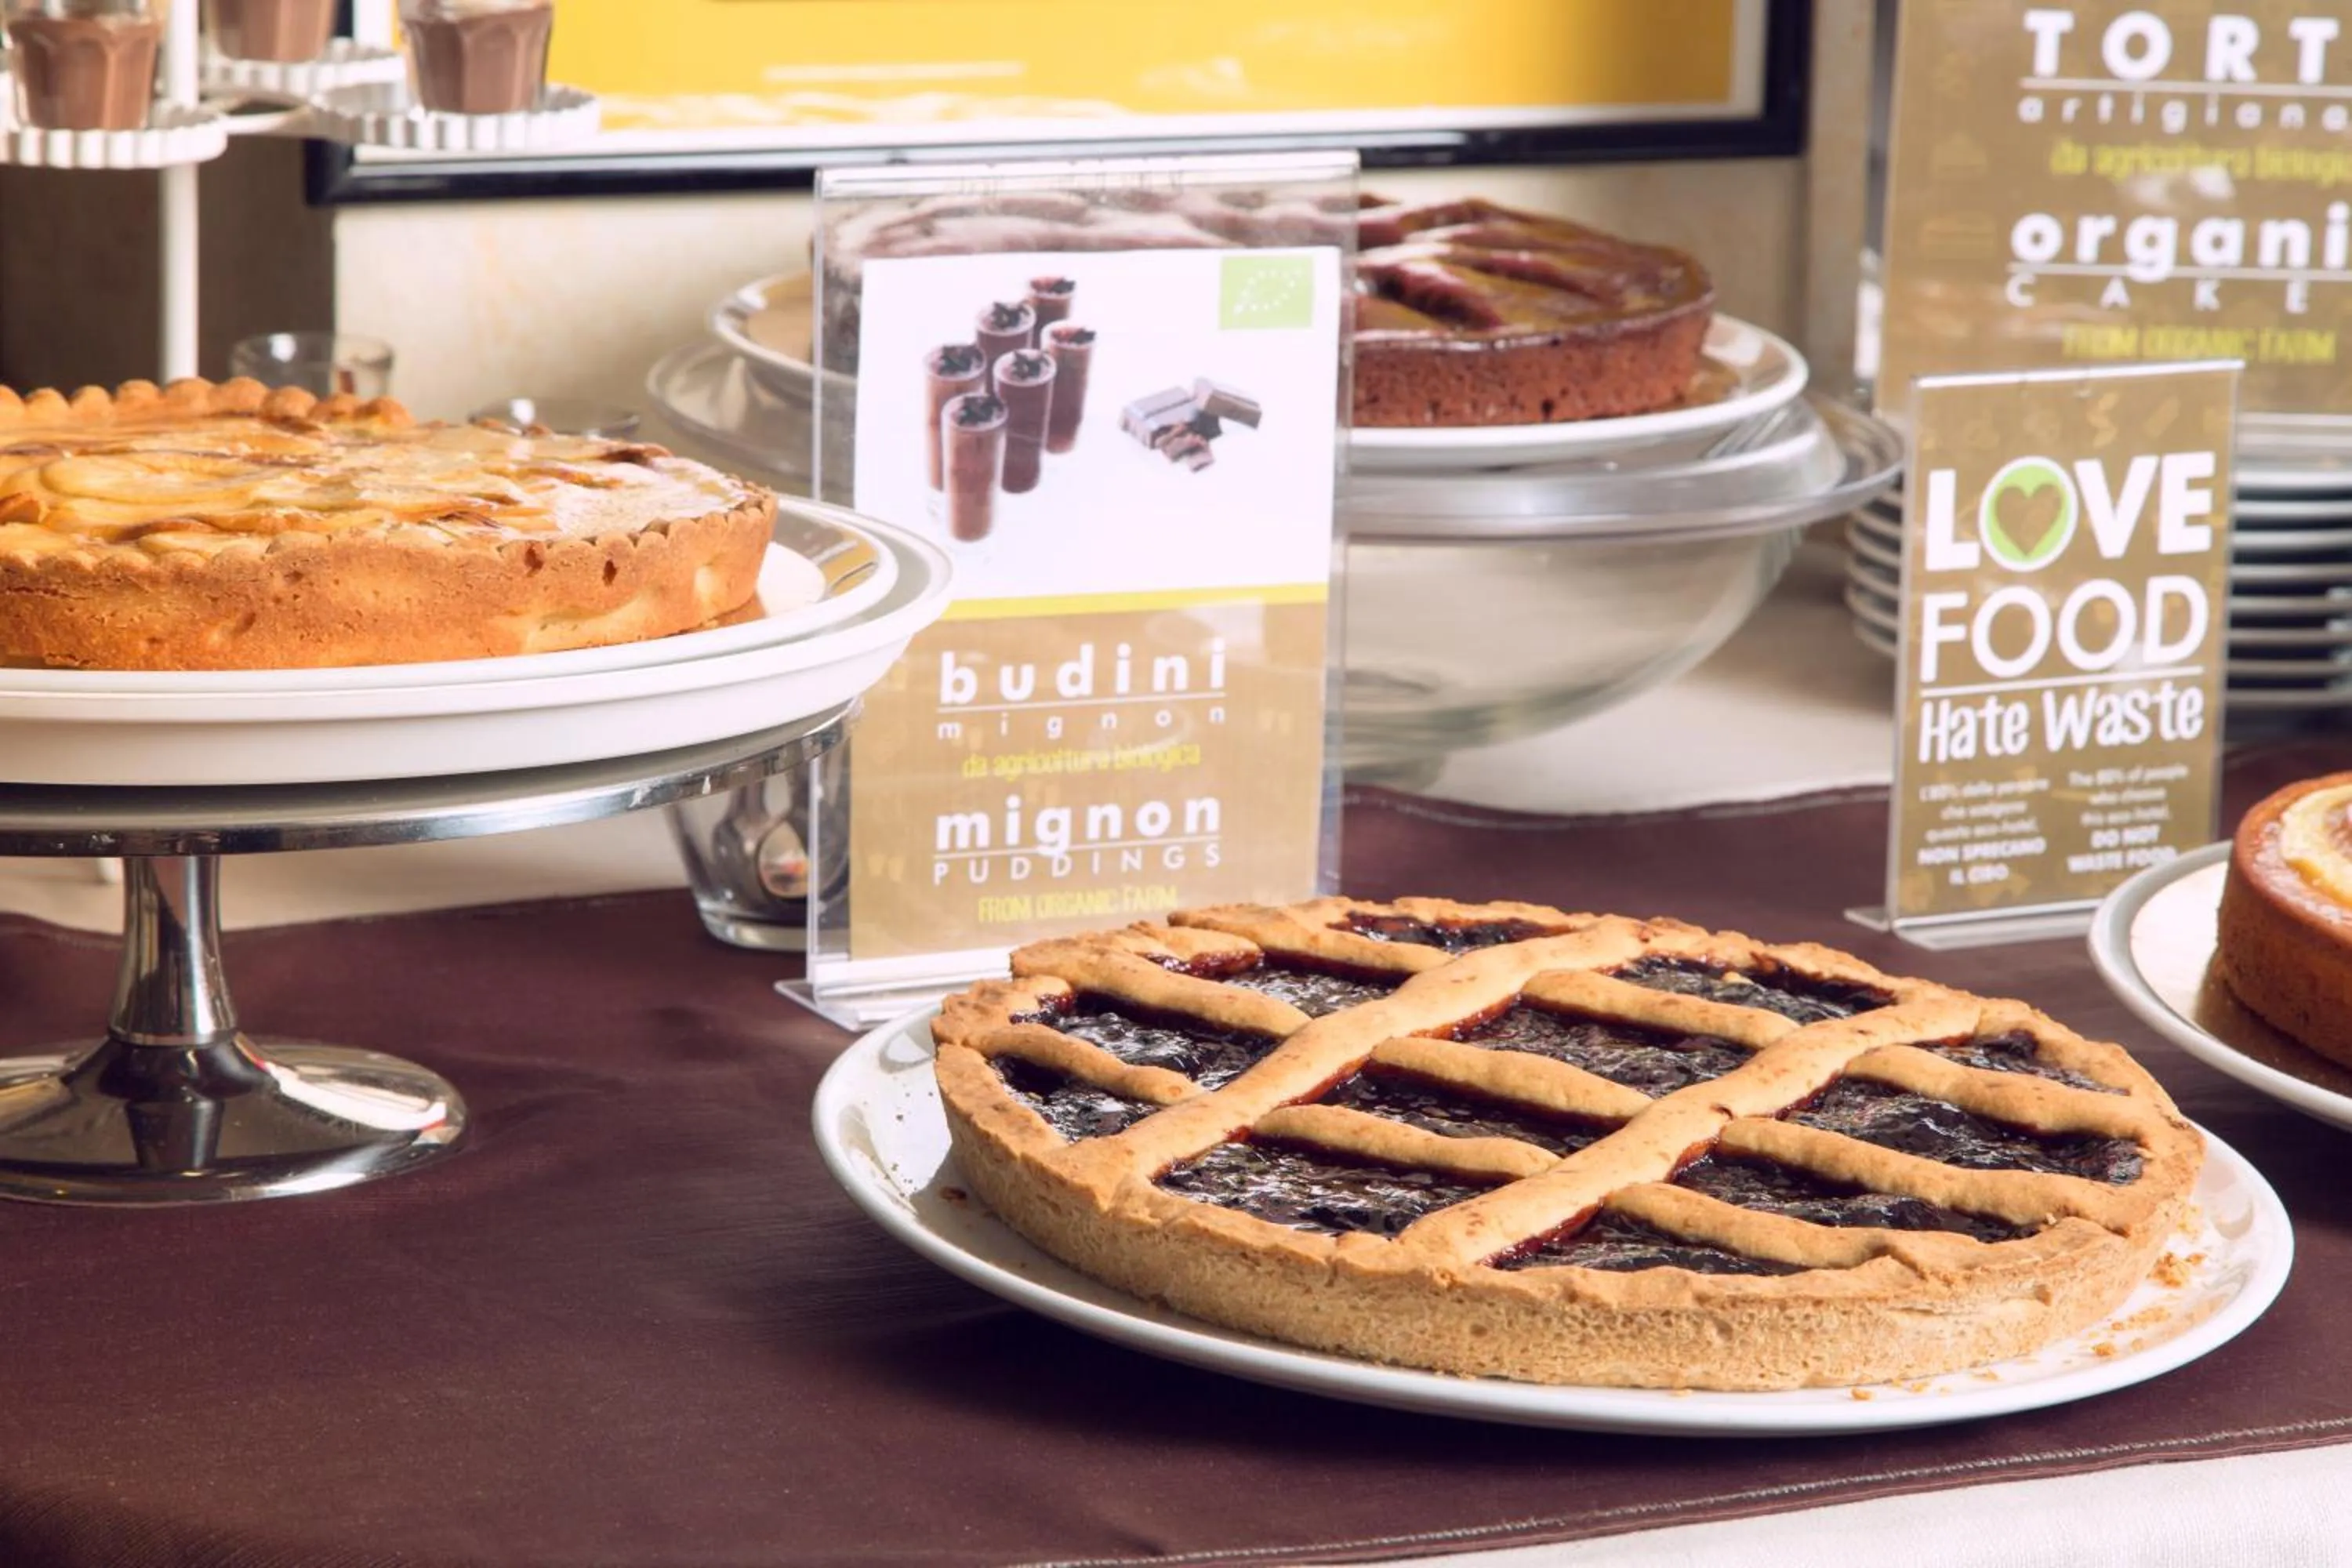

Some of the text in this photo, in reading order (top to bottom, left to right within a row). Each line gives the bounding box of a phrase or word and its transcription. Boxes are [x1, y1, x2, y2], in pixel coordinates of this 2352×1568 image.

[2023, 9, 2339, 84] TORT
[2011, 201, 2350, 283] organi
[2005, 274, 2309, 314] CAKE
[1925, 451, 2216, 572] LOVE
[1920, 575, 2209, 683] FOOD
[940, 637, 1226, 704] budini
[938, 706, 1225, 740] mignon
[1918, 679, 2205, 764] Hate Waste
[961, 753, 987, 778] da
[935, 793, 1221, 858] mignon
[933, 844, 1221, 886] PUDDINGS
[978, 884, 1178, 923] FROM ORGANIC FARM
